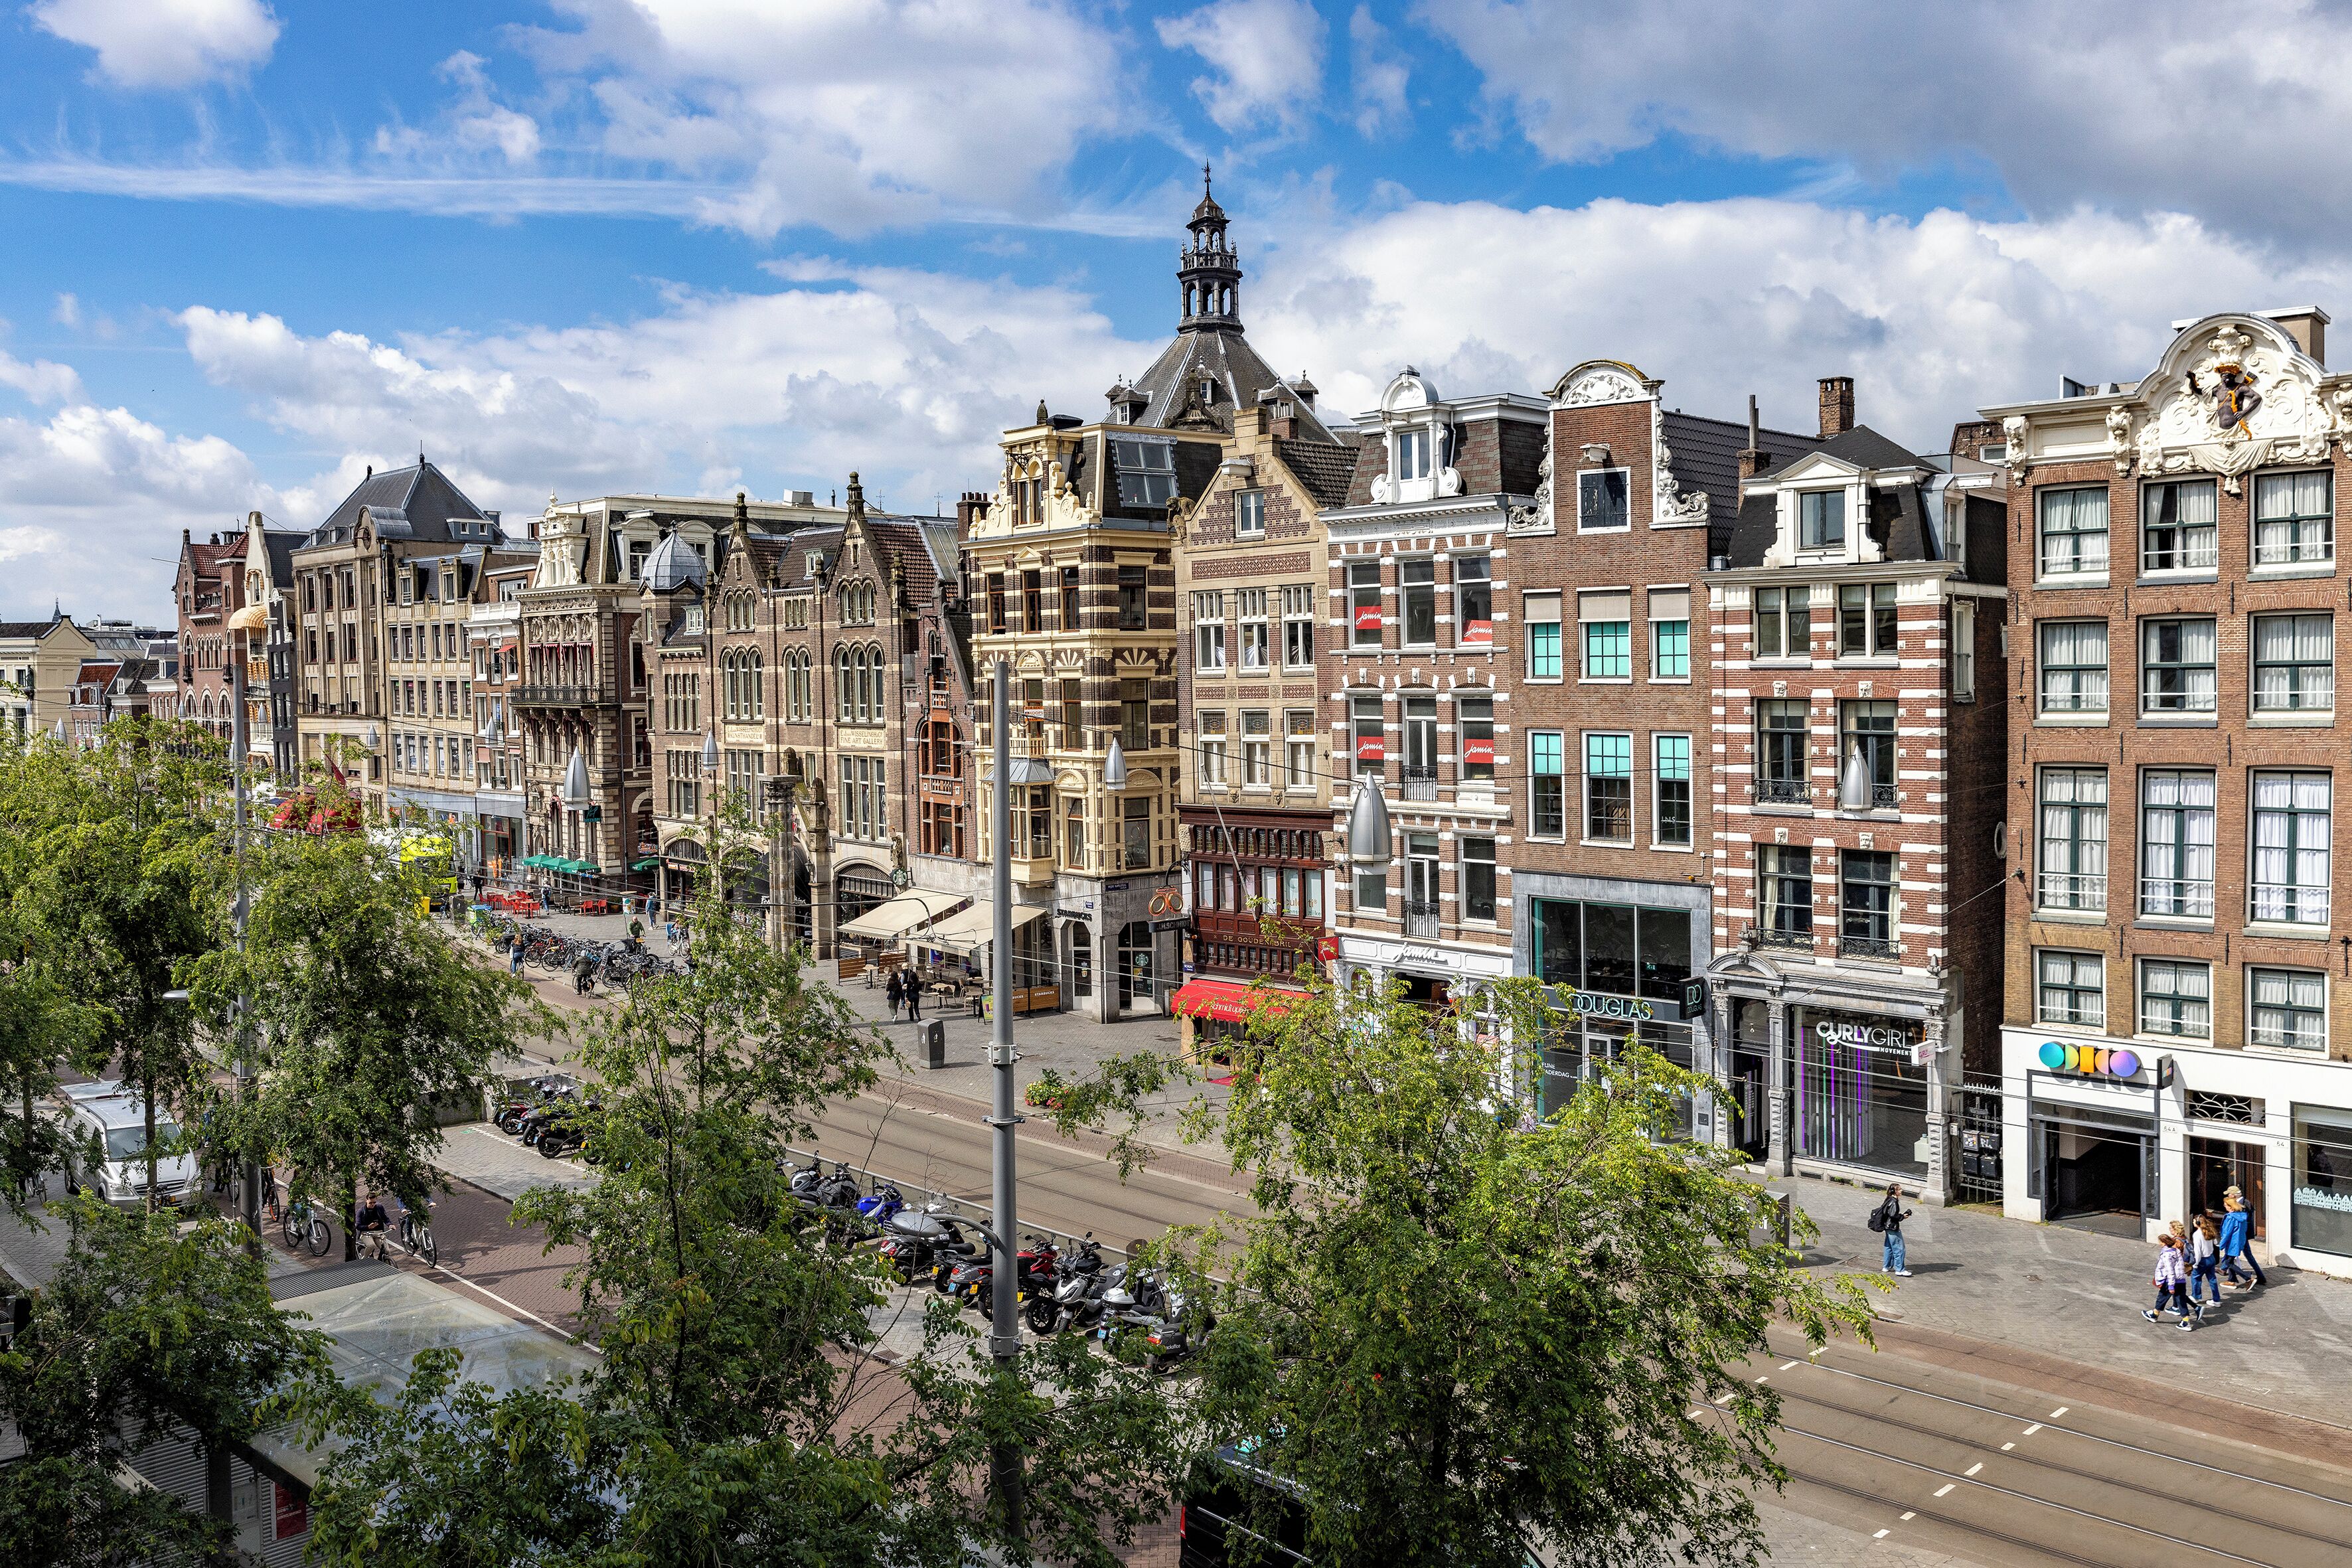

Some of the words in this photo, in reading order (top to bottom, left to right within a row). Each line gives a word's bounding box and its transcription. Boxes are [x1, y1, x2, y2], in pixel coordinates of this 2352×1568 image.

[1358, 741, 1384, 754] jamin
[1464, 744, 1494, 757] jamin
[1057, 908, 1092, 922] STARBUCKS
[1237, 937, 1271, 946] GOUDEN
[1273, 939, 1291, 948] BRIL
[1569, 993, 1652, 1020] DOUGLAS
[1687, 1004, 1702, 1014] DOUGLAS
[1879, 1047, 1912, 1056] MOVEMENT
